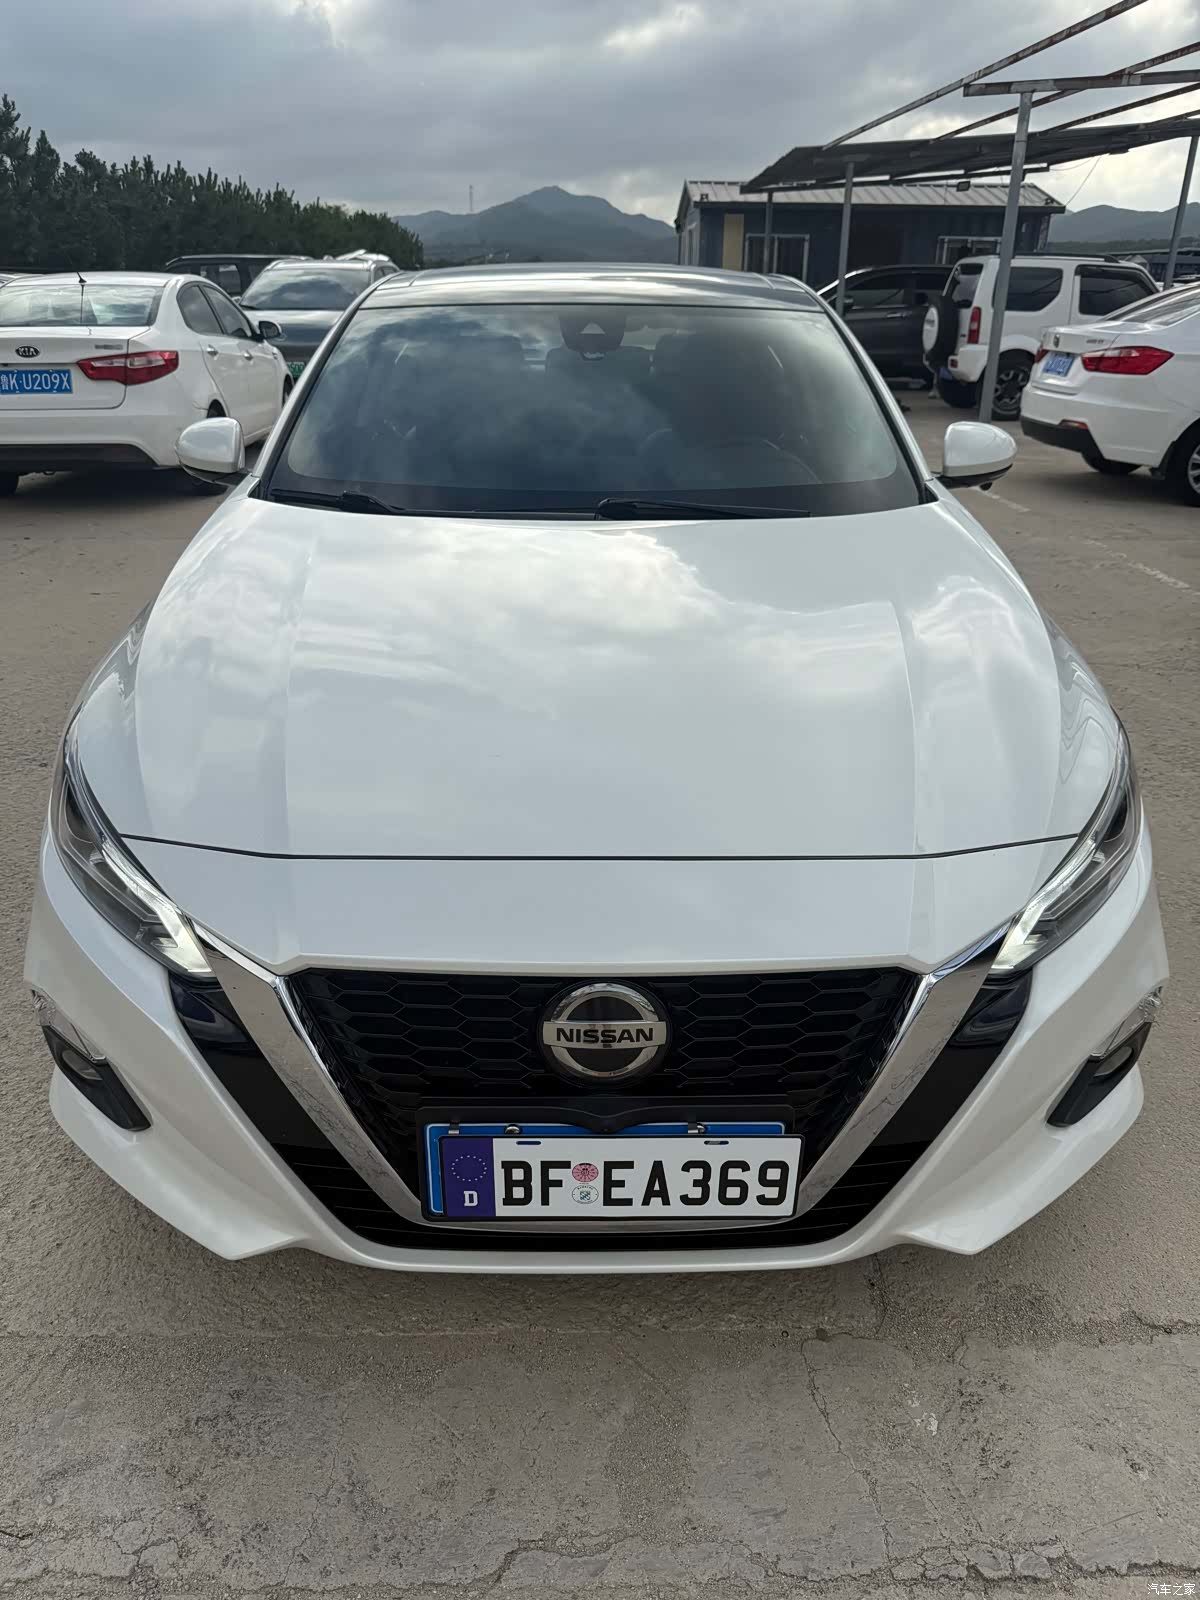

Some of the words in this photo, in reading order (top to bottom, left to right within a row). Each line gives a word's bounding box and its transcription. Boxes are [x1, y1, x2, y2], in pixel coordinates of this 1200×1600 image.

[18, 347, 37, 356] KIA
[556, 1027, 654, 1044] NISSAN
[463, 1190, 478, 1207] D
[501, 1160, 572, 1206] BF
[602, 1160, 790, 1206] EA369
